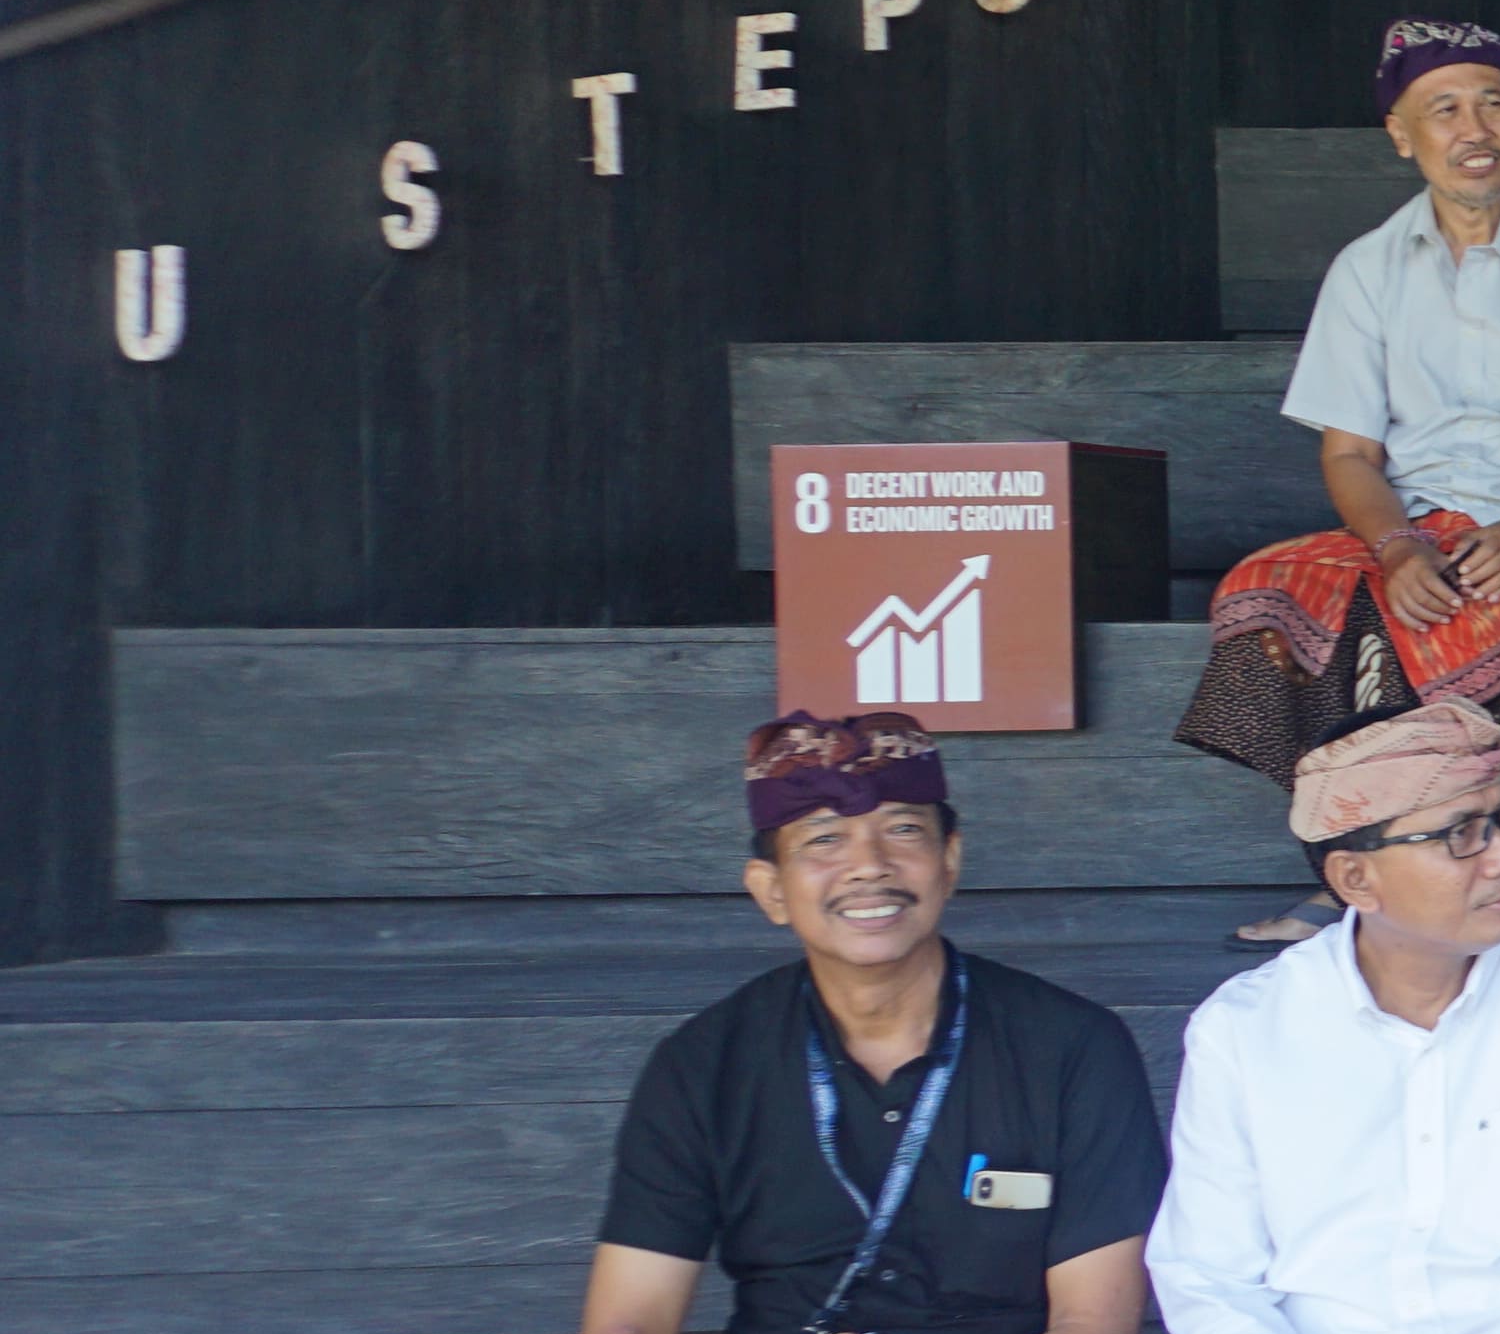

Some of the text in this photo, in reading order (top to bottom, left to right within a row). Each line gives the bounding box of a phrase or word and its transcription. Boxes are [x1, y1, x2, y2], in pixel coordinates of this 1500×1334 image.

[845, 471, 1044, 498] DECENT WORK AND
[795, 473, 830, 533] 8
[847, 504, 1053, 533] ECONOMIC GROWTH
